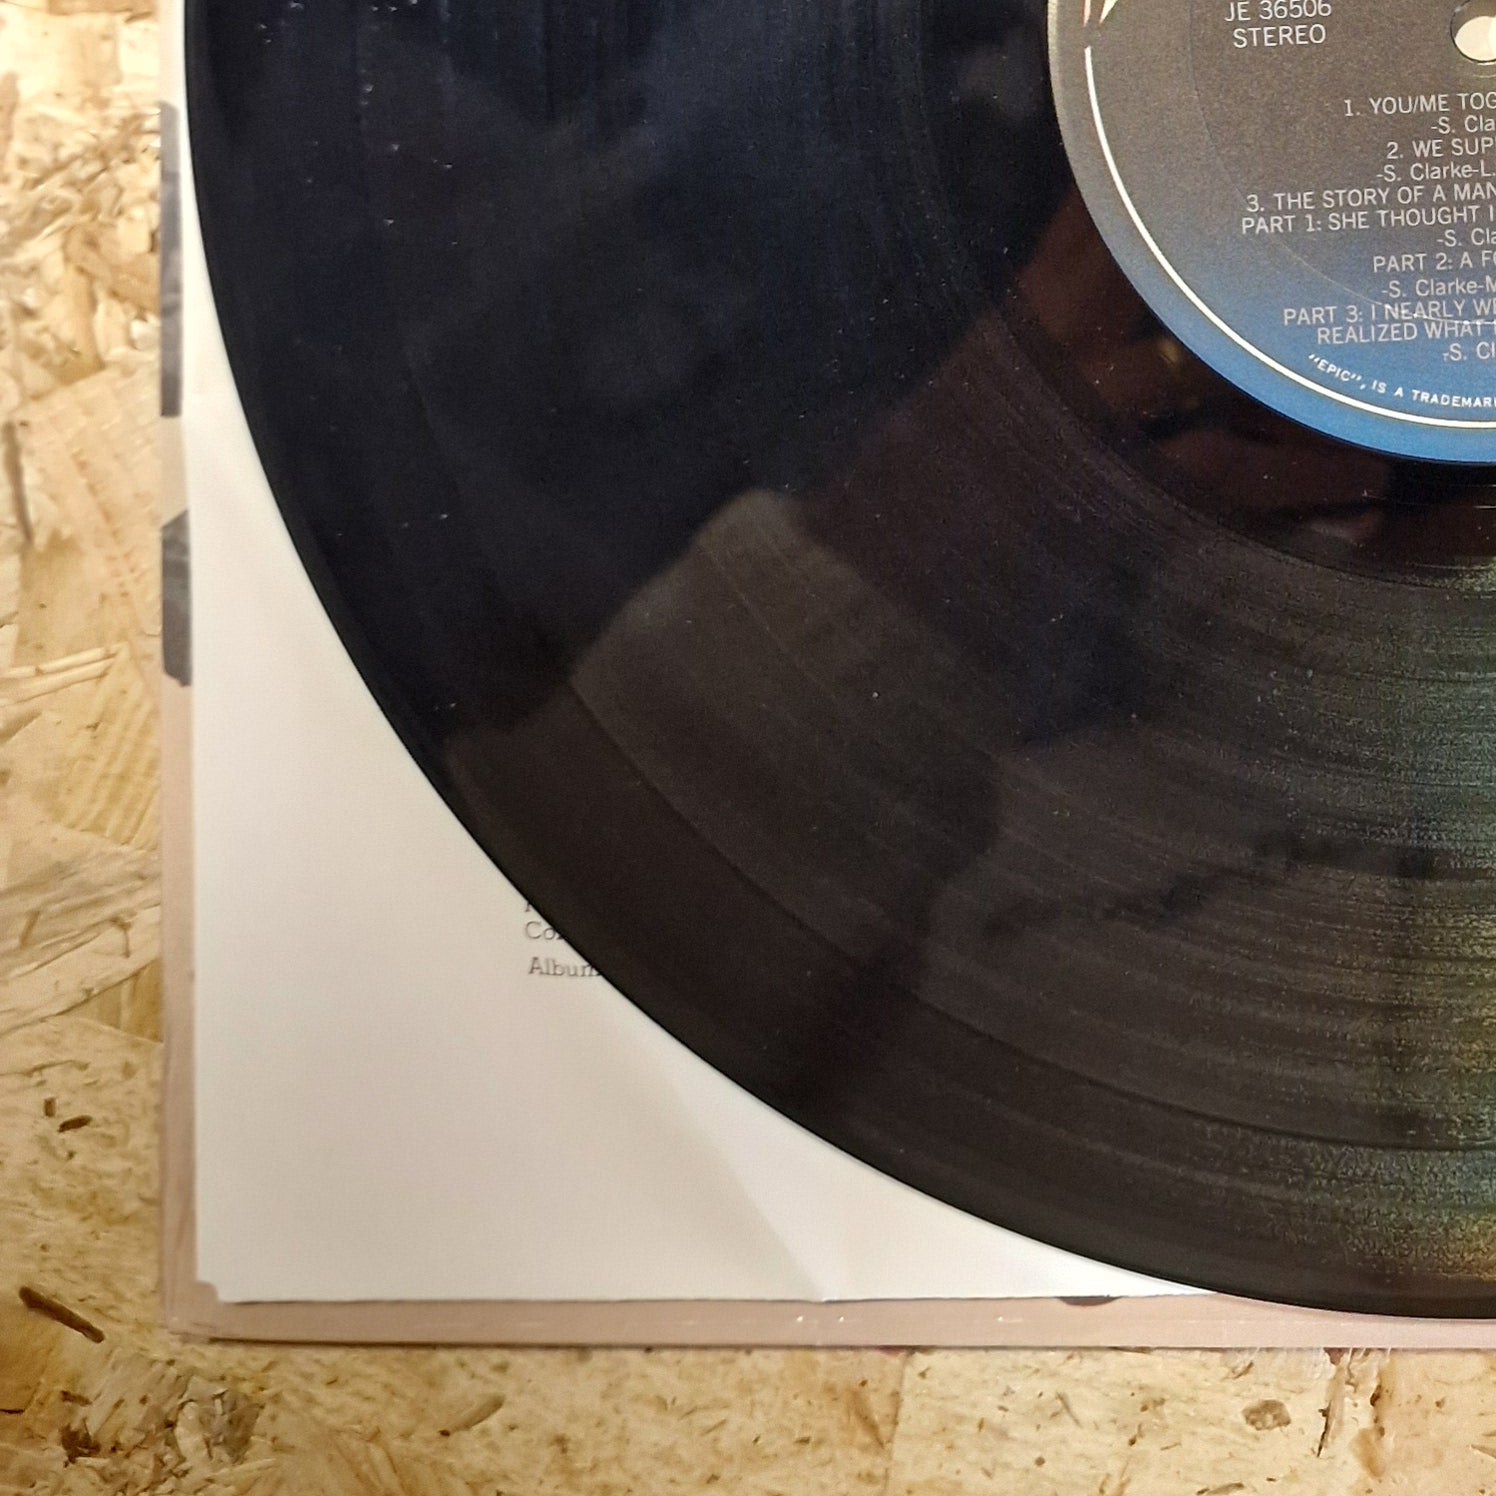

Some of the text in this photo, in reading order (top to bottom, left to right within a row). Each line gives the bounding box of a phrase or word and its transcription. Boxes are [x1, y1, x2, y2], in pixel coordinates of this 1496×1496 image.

[1224, 2, 1251, 22] JE
[1233, 23, 1326, 48] STEREO
[1344, 99, 1360, 117] 1.
[1369, 94, 1450, 115] YOU/ME
[1386, 142, 1404, 159] 2.
[1412, 139, 1444, 157] WE
[1246, 194, 1264, 213] 3.
[1274, 191, 1315, 210] THE
[1323, 188, 1389, 208] STORY
[1397, 185, 1424, 204] OF
[1432, 184, 1446, 202] A
[1242, 215, 1296, 234] PART
[1305, 214, 1322, 232] 1:
[1328, 211, 1370, 231] SHE
[1376, 205, 1480, 227] THOUGHT
[1489, 205, 1494, 221] I
[1373, 253, 1427, 272] PART
[1436, 253, 1453, 271] 2:
[1460, 251, 1474, 268] A
[1284, 306, 1337, 325] PART
[1346, 305, 1363, 323] 3:
[1371, 304, 1376, 320] I
[1385, 300, 1465, 320] NEARLY
[1318, 323, 1417, 344] REALIZED
[1425, 319, 1484, 339] WHAT
[1371, 380, 1387, 393] IS
[1394, 387, 1404, 397] A
